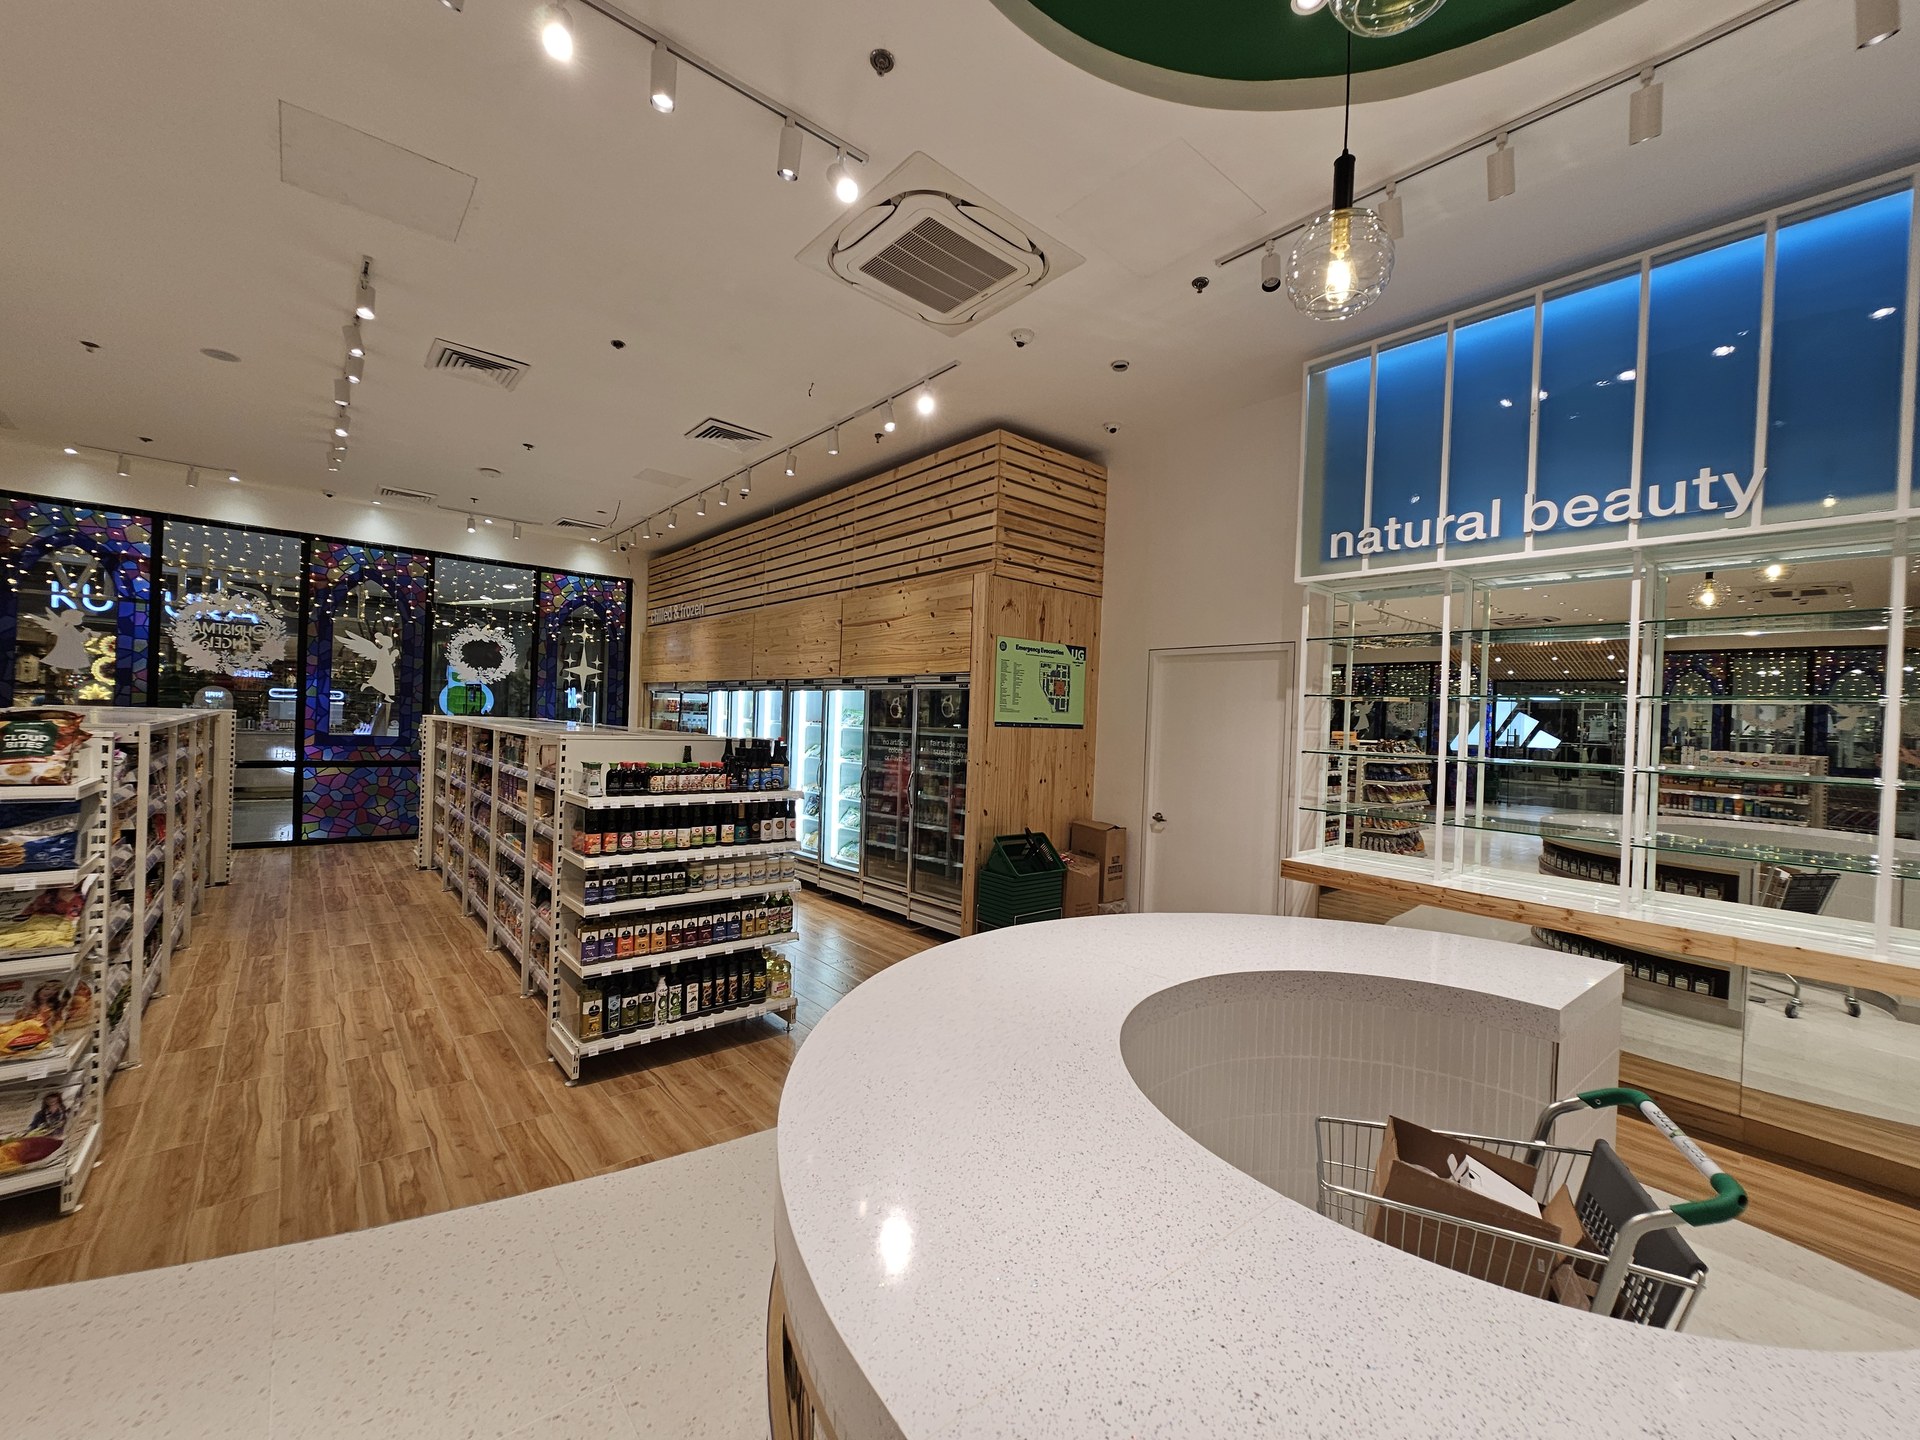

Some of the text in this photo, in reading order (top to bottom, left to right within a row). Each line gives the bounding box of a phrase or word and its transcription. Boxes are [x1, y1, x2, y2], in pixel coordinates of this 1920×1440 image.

[1330, 467, 1768, 559] natural beauty
[651, 603, 704, 624] chilled & frozen
[1015, 643, 1040, 654] Emergency
[1040, 647, 1064, 656] Evacuation
[1071, 649, 1085, 661] UG
[3, 733, 51, 742] CLOUD
[5, 741, 45, 749] BITES
